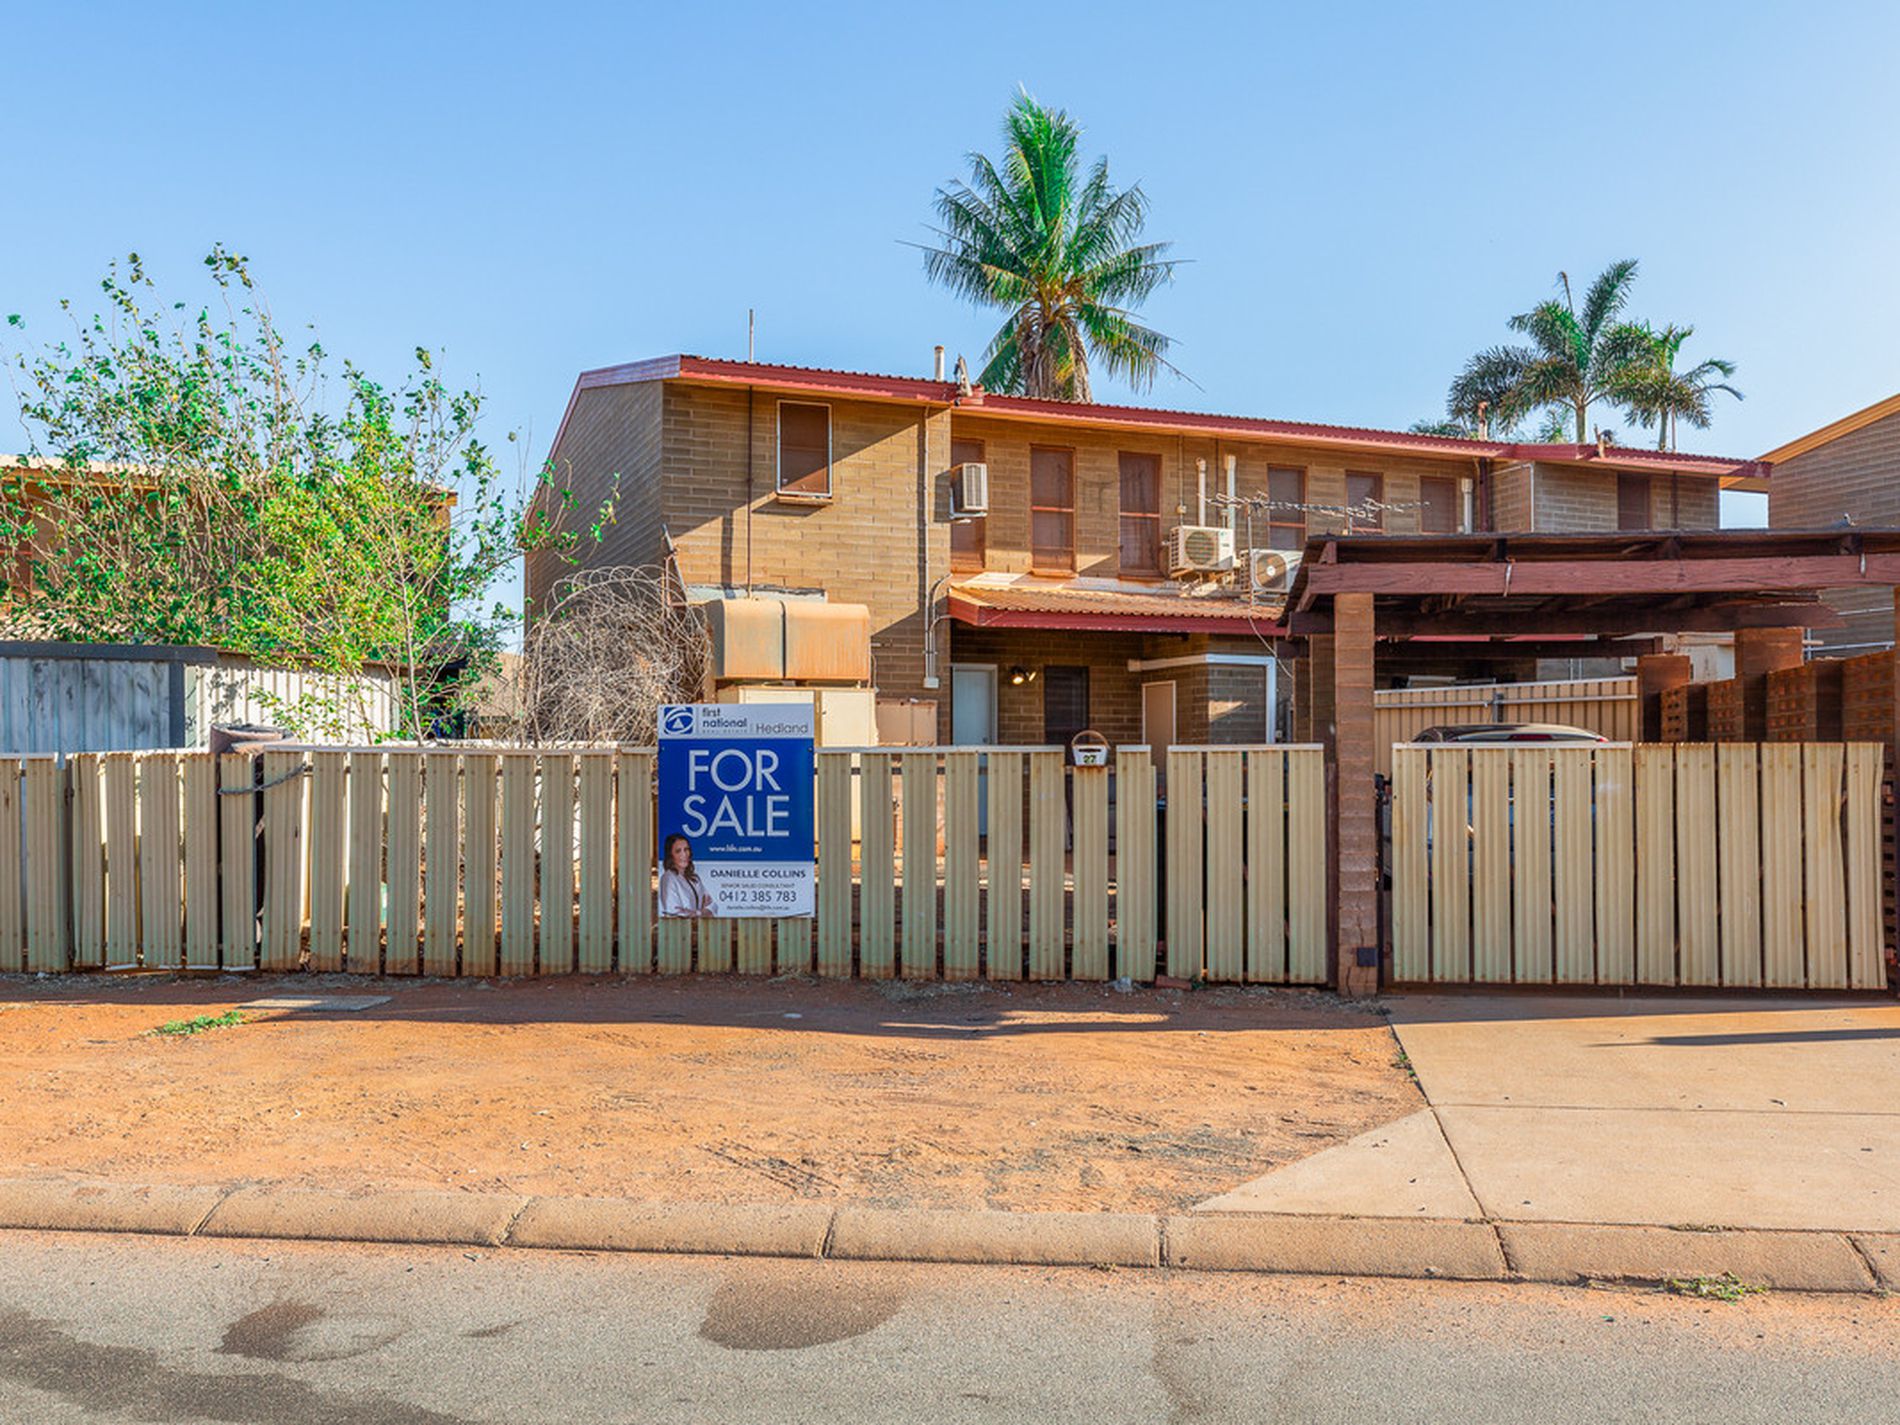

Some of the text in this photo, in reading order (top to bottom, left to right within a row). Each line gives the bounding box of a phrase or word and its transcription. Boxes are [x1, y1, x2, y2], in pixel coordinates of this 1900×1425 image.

[702, 707, 721, 717] first
[702, 718, 747, 728] national
[756, 723, 808, 734] Hedland
[1083, 755, 1096, 763] 27
[689, 749, 782, 792] FOR
[682, 795, 790, 838] SALE
[710, 869, 806, 878] DANIELLE COLLINS
[719, 890, 797, 902] 0412 385 783
